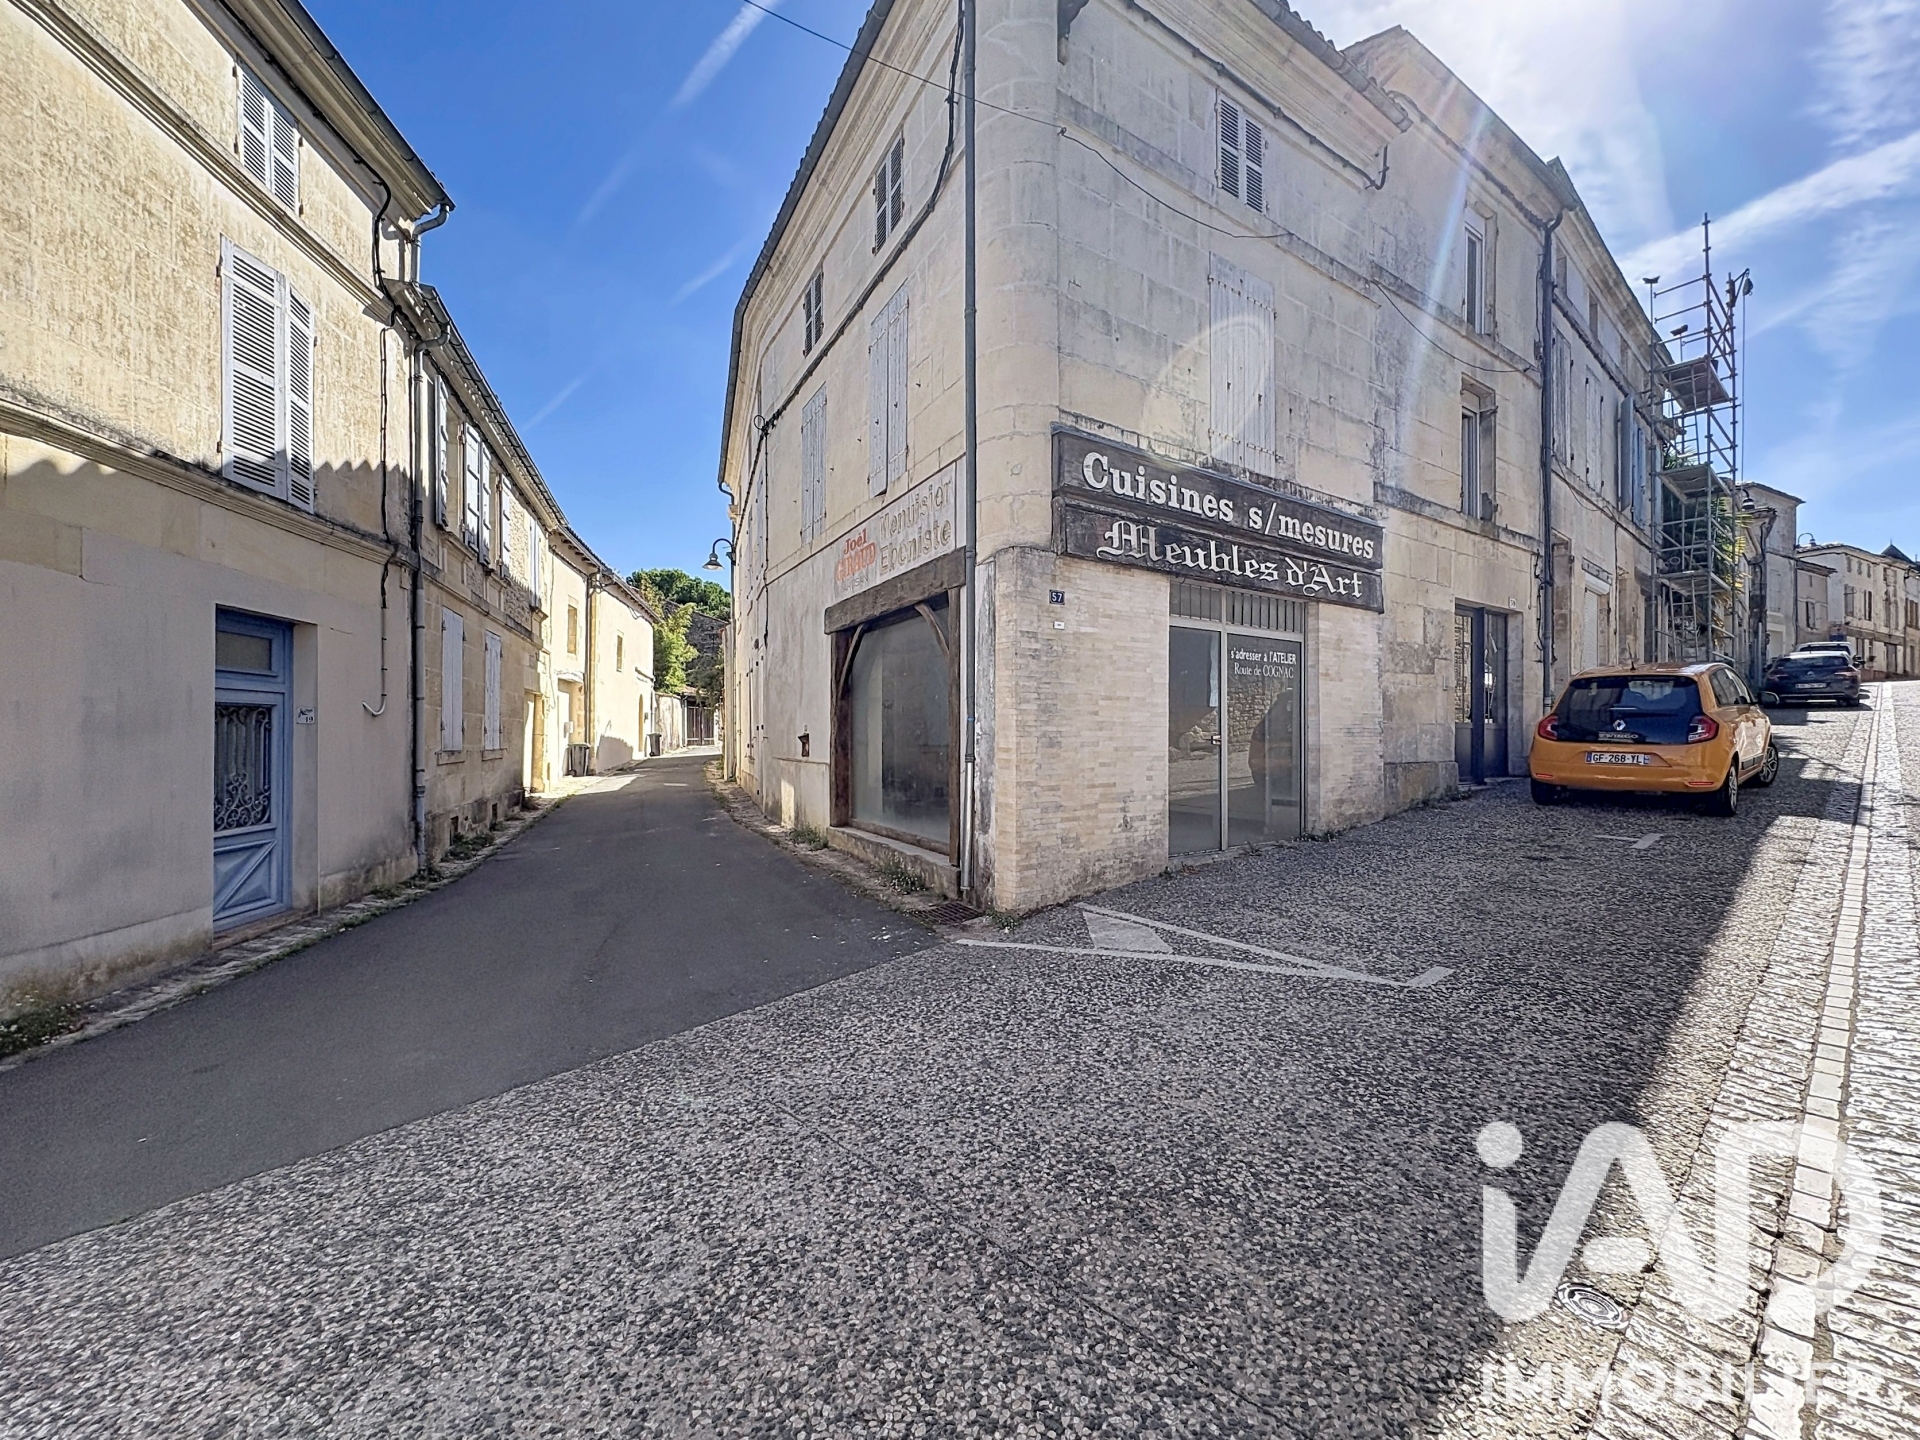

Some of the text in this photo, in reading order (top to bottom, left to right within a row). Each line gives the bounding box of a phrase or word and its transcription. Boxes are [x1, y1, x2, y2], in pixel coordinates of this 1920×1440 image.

[880, 480, 952, 540] Menuisier
[1082, 451, 1375, 560] Cuisines s/mesures
[1096, 520, 1364, 599] Meubles d'Art
[1052, 592, 1062, 602] 57
[1230, 647, 1262, 662] s'adresser
[1269, 651, 1297, 665] l'ATELIER
[1234, 662, 1294, 679] Route de COGNAC
[1592, 753, 1642, 763] GF-268-YL
